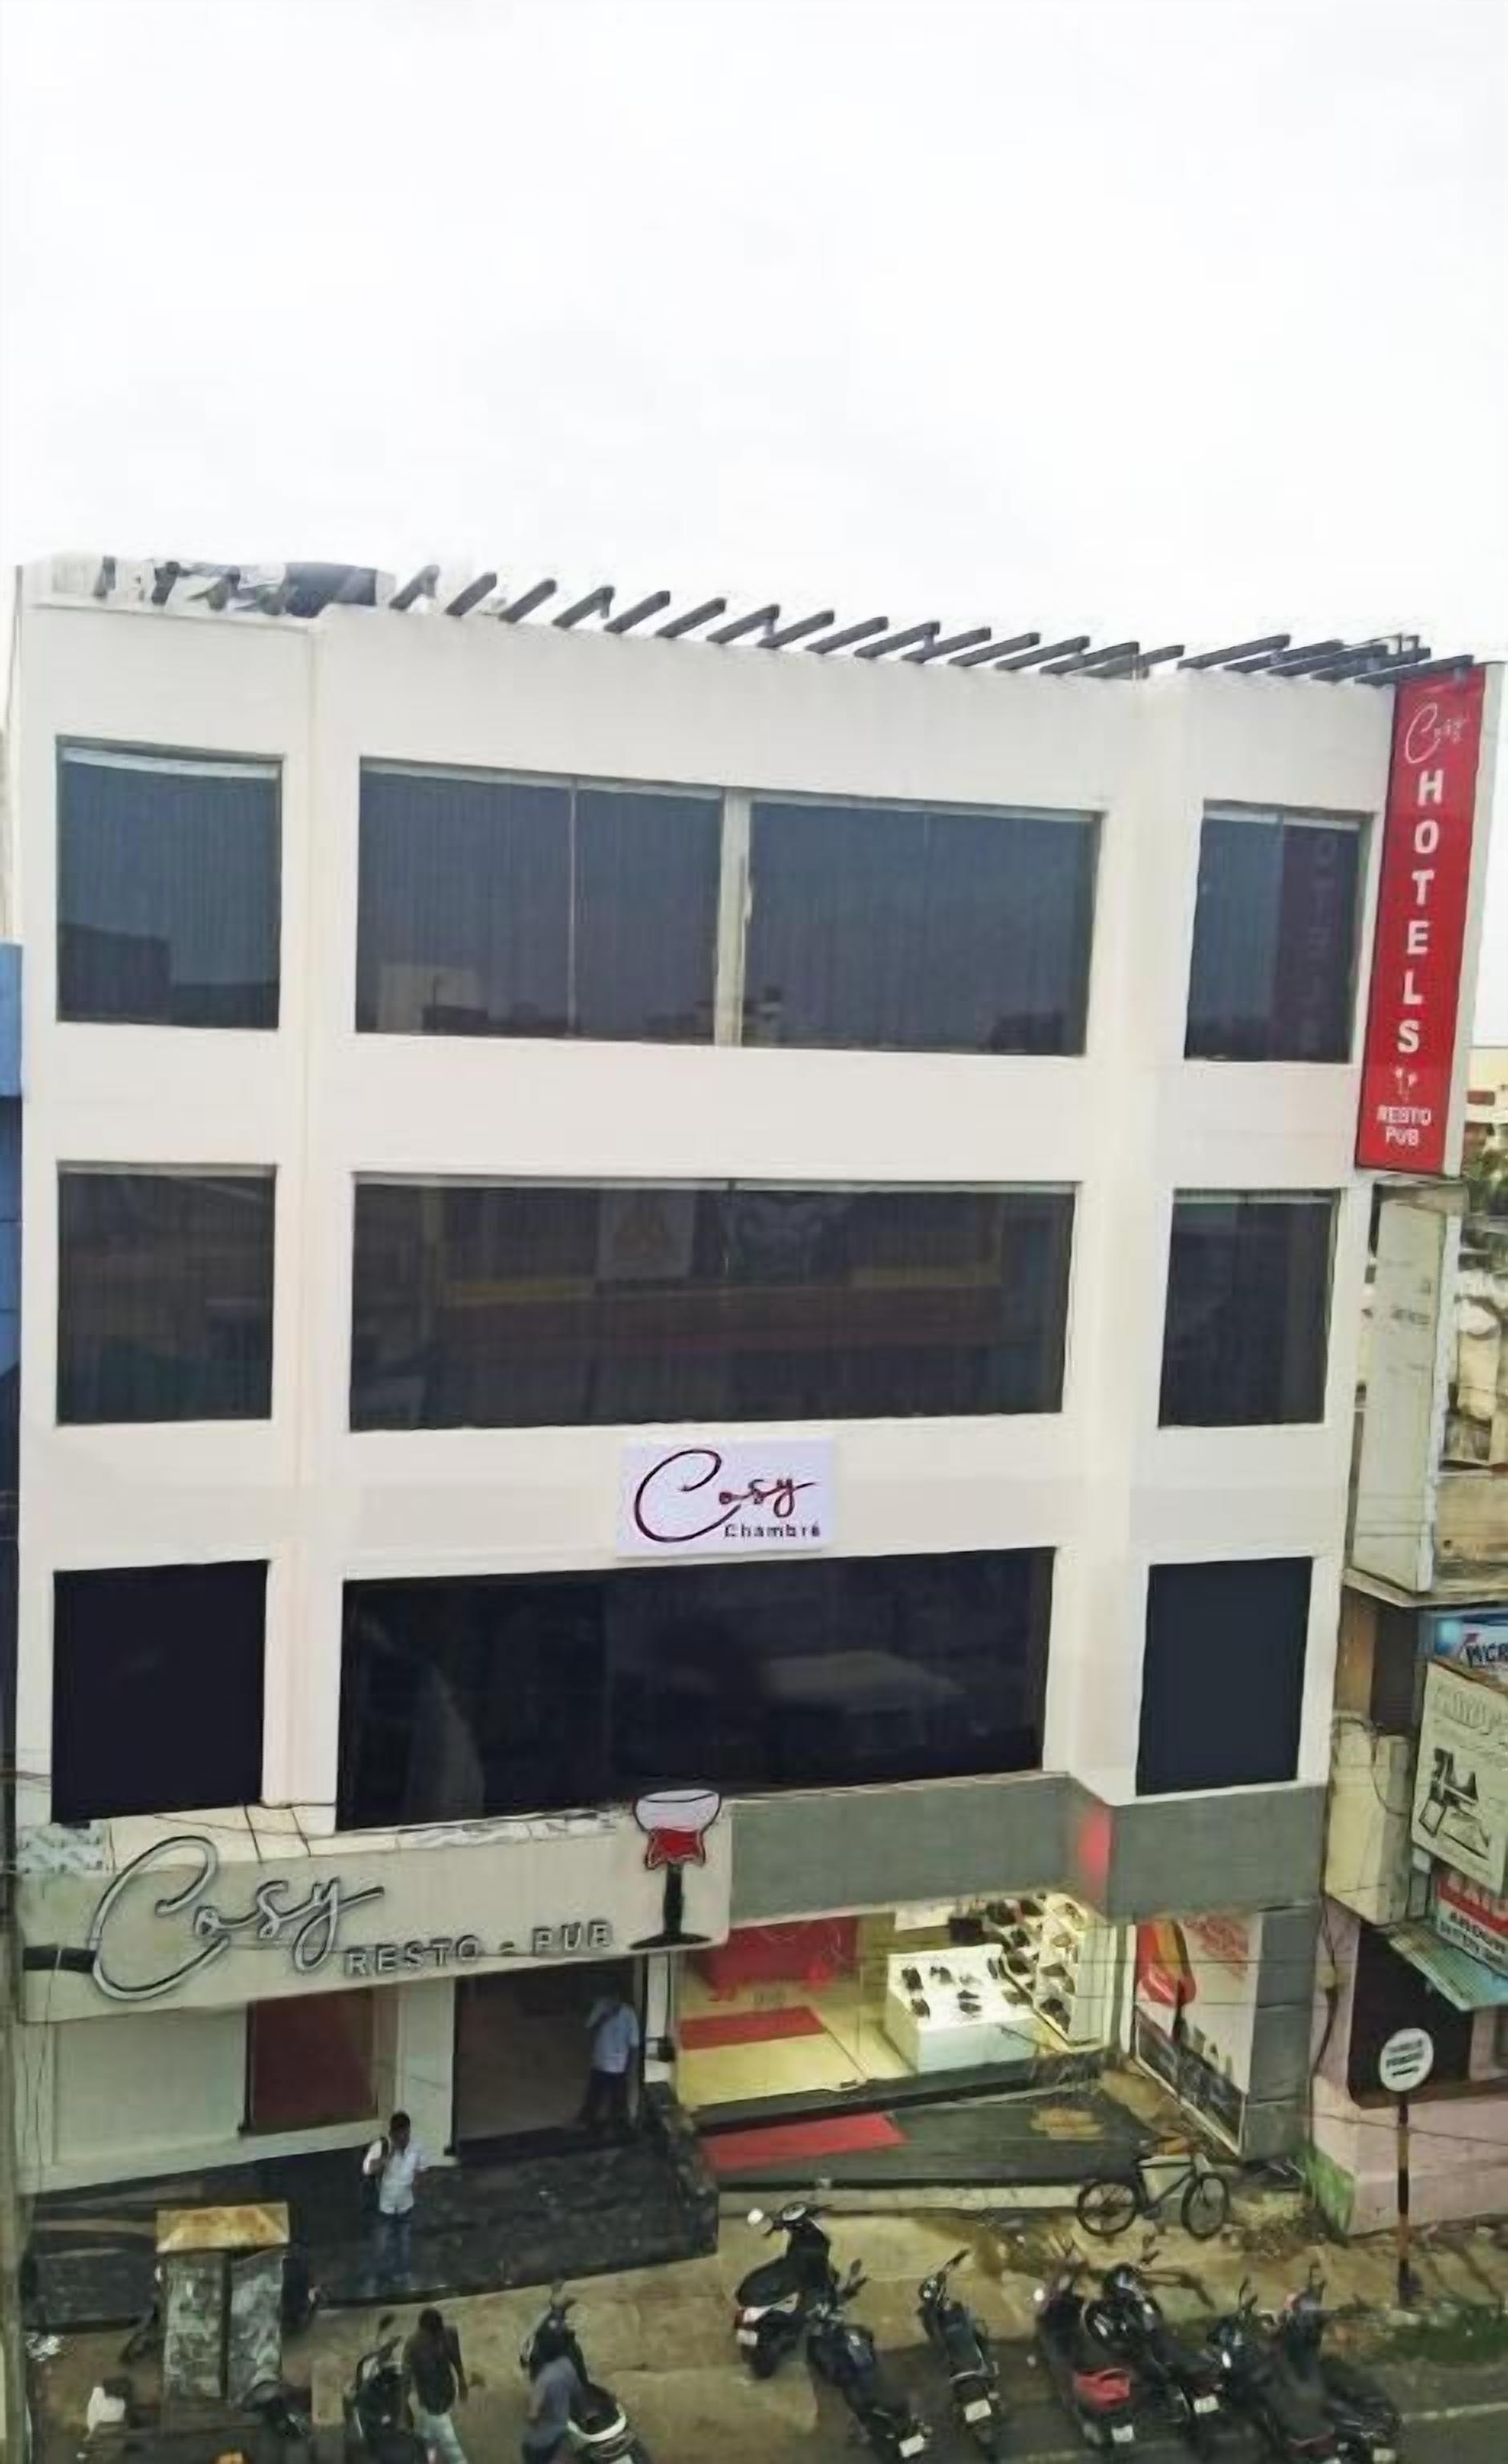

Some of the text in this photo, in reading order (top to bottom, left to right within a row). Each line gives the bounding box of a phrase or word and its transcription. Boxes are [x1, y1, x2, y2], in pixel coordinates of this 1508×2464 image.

[1397, 768, 1444, 1055] HOTELS
[1385, 1125, 1419, 1146] PUB
[634, 1448, 821, 1543] Cosy
[89, 1834, 385, 2002] Cosy
[345, 1934, 480, 1976] RESTO
[531, 1918, 613, 1956] PUB
